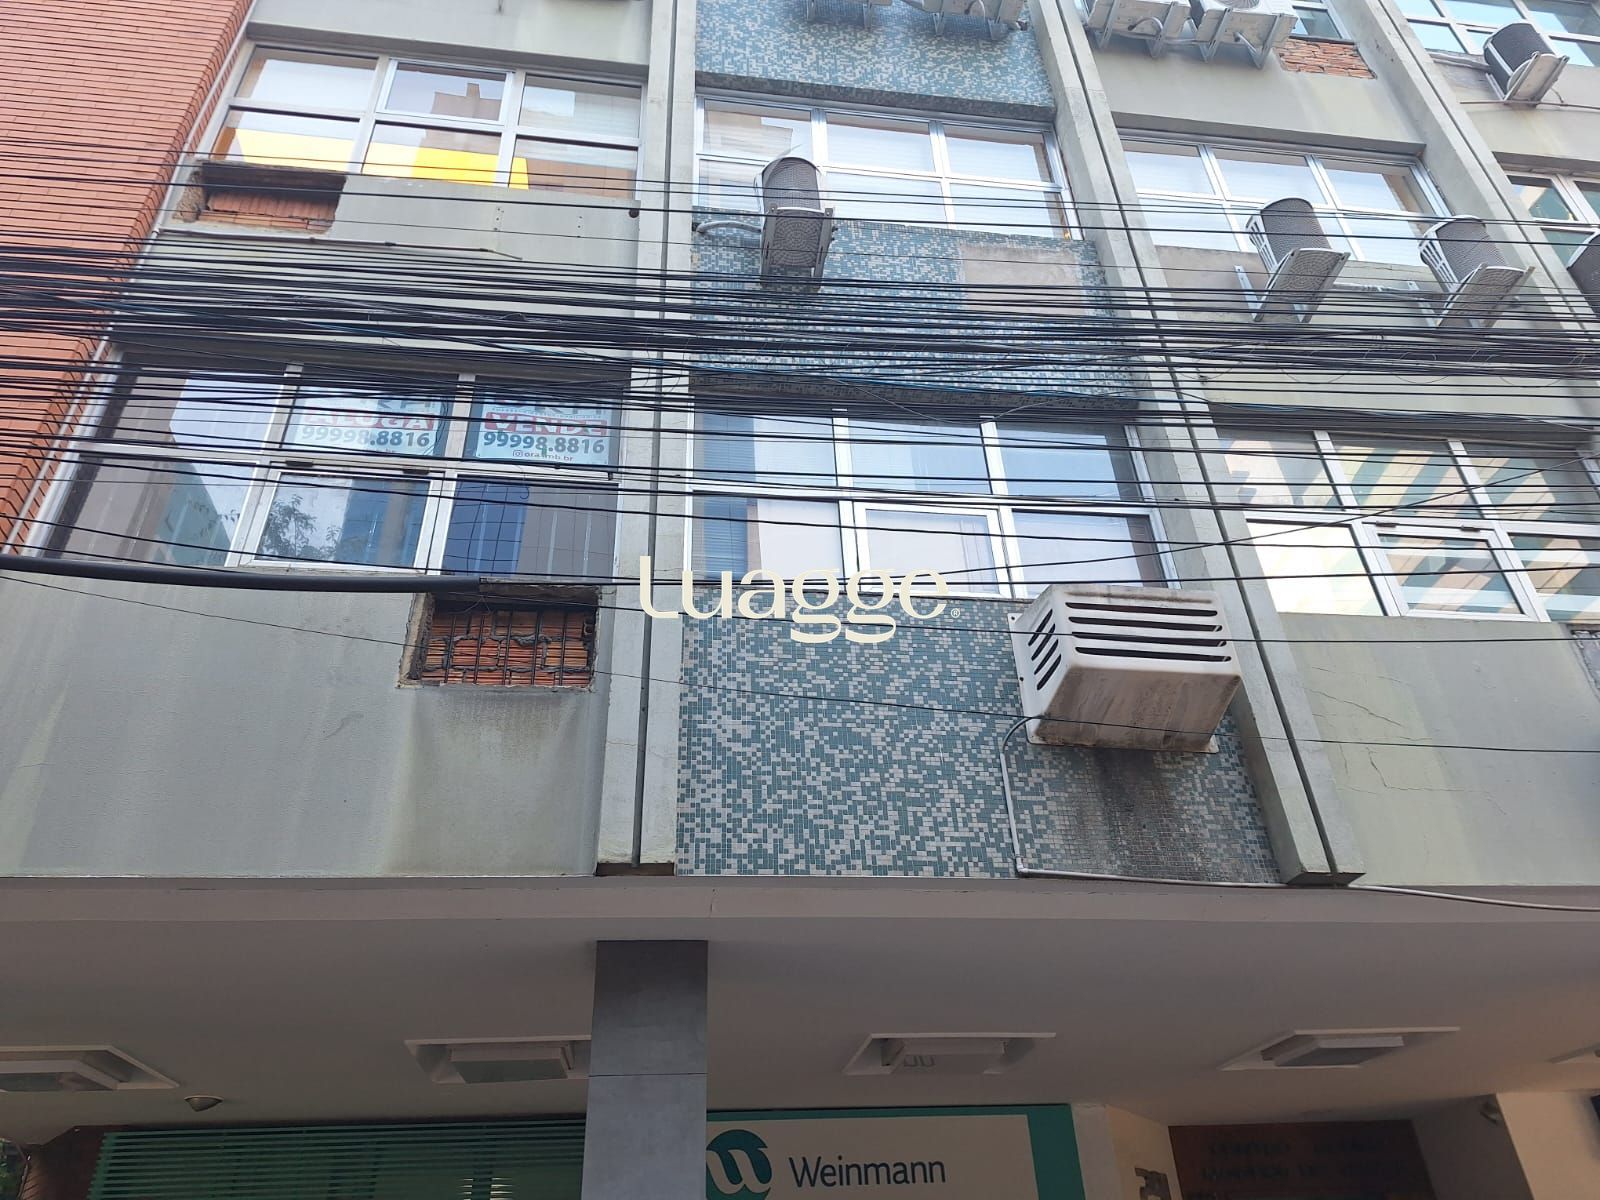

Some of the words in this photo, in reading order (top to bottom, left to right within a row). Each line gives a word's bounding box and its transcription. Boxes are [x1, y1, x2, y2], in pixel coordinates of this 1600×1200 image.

[489, 413, 606, 436] VENDE
[302, 426, 430, 447] 99998.8816
[484, 432, 605, 454] 99998.8816
[789, 1155, 946, 1187] Weinmann
